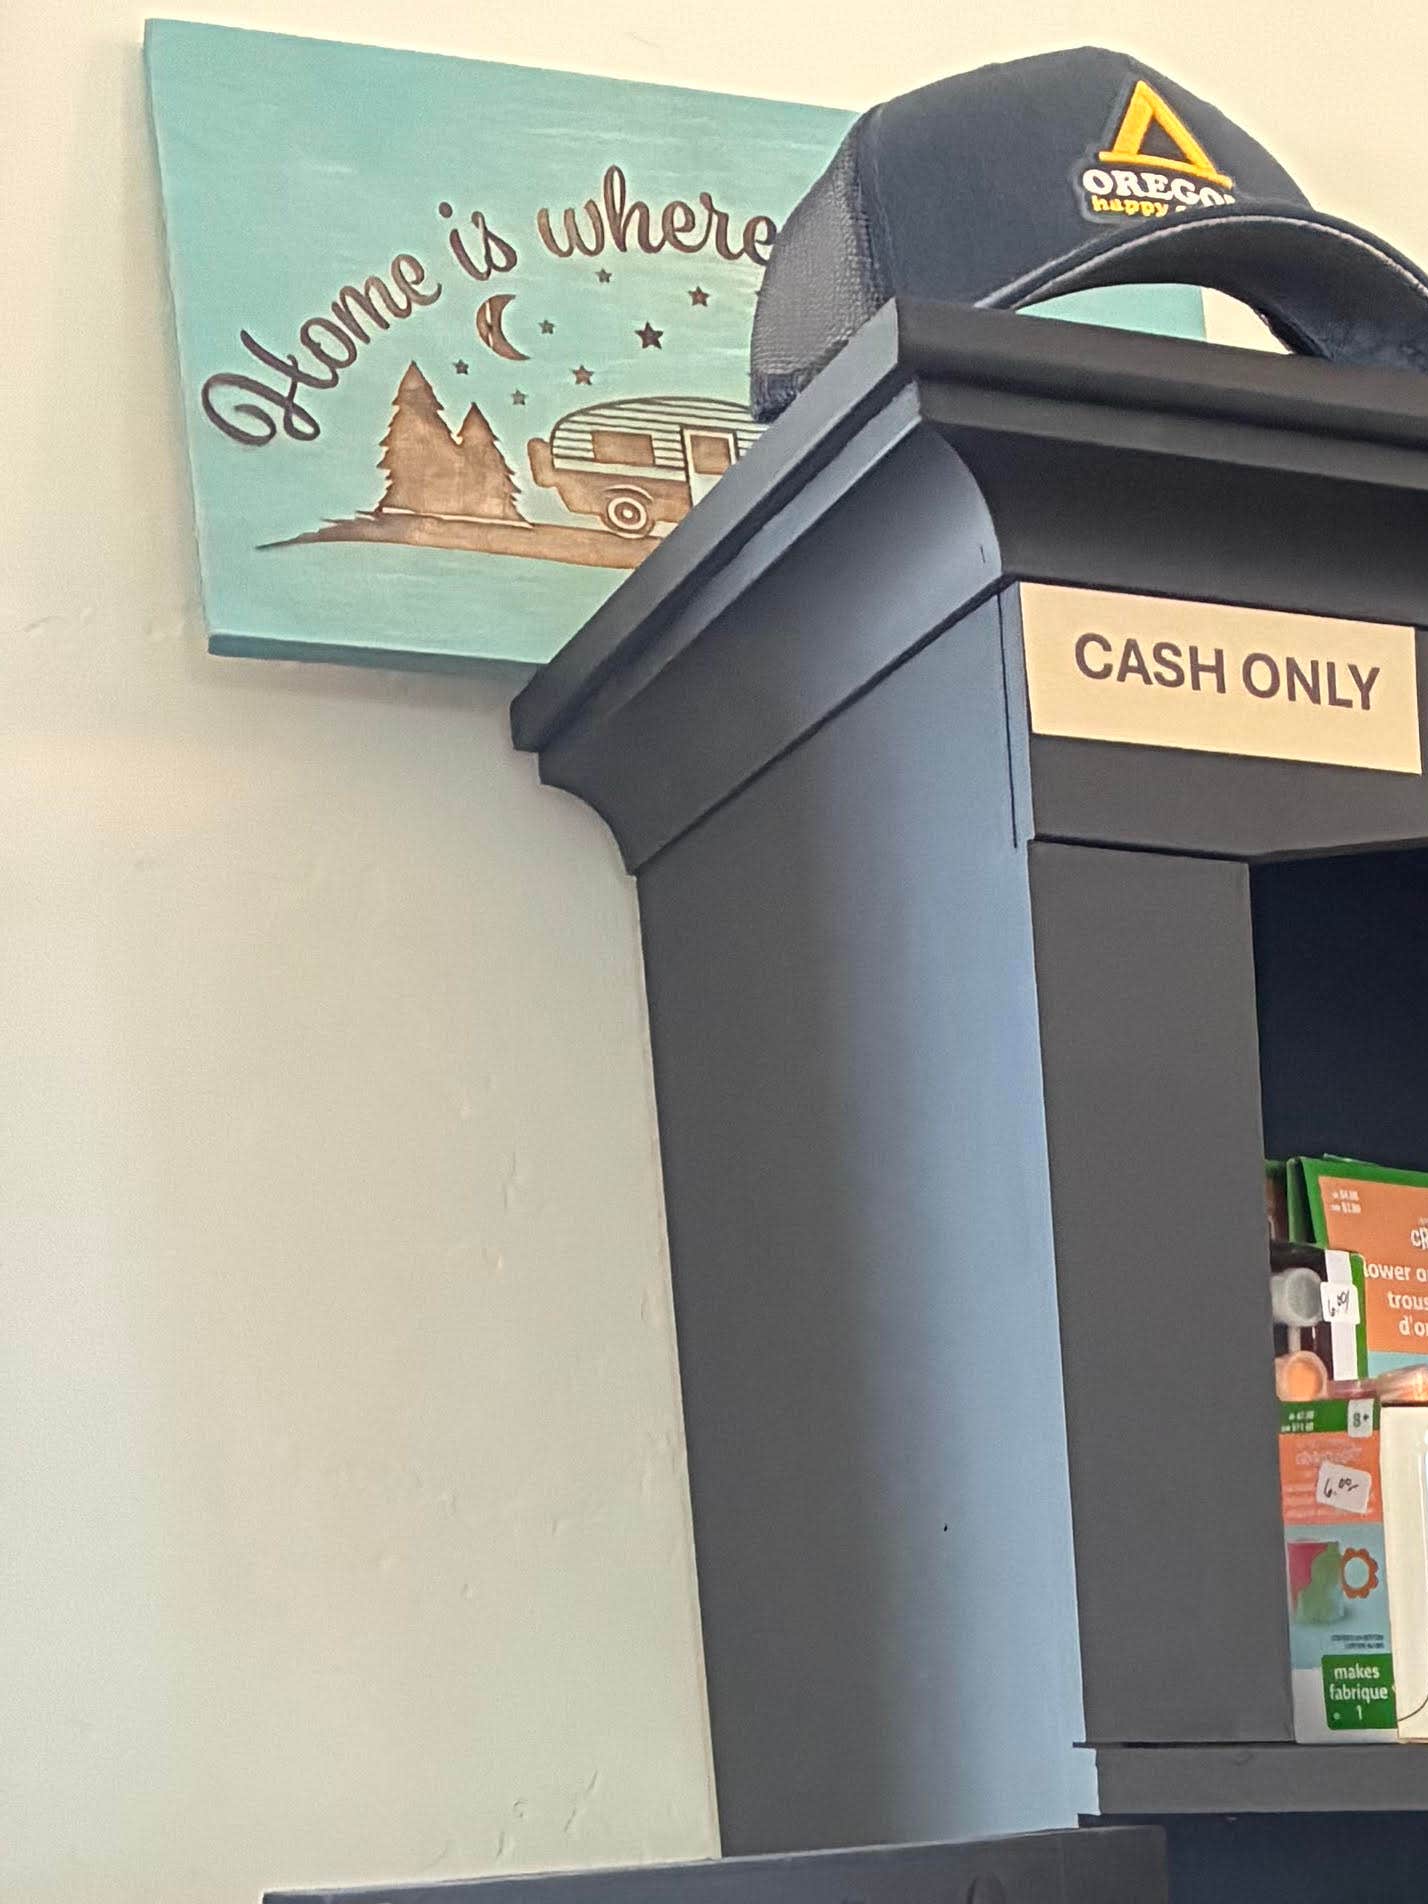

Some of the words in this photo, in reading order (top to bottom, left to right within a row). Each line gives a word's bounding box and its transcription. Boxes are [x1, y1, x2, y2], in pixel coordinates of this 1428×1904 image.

[1082, 168, 1236, 206] OREGO
[201, 250, 442, 450] Home
[436, 200, 519, 283] is
[536, 163, 780, 270] where
[1073, 631, 1228, 698] CASH
[1239, 650, 1382, 714] ONLY
[1334, 1665, 1381, 1681] makes
[1328, 1682, 1389, 1704] fabrique
